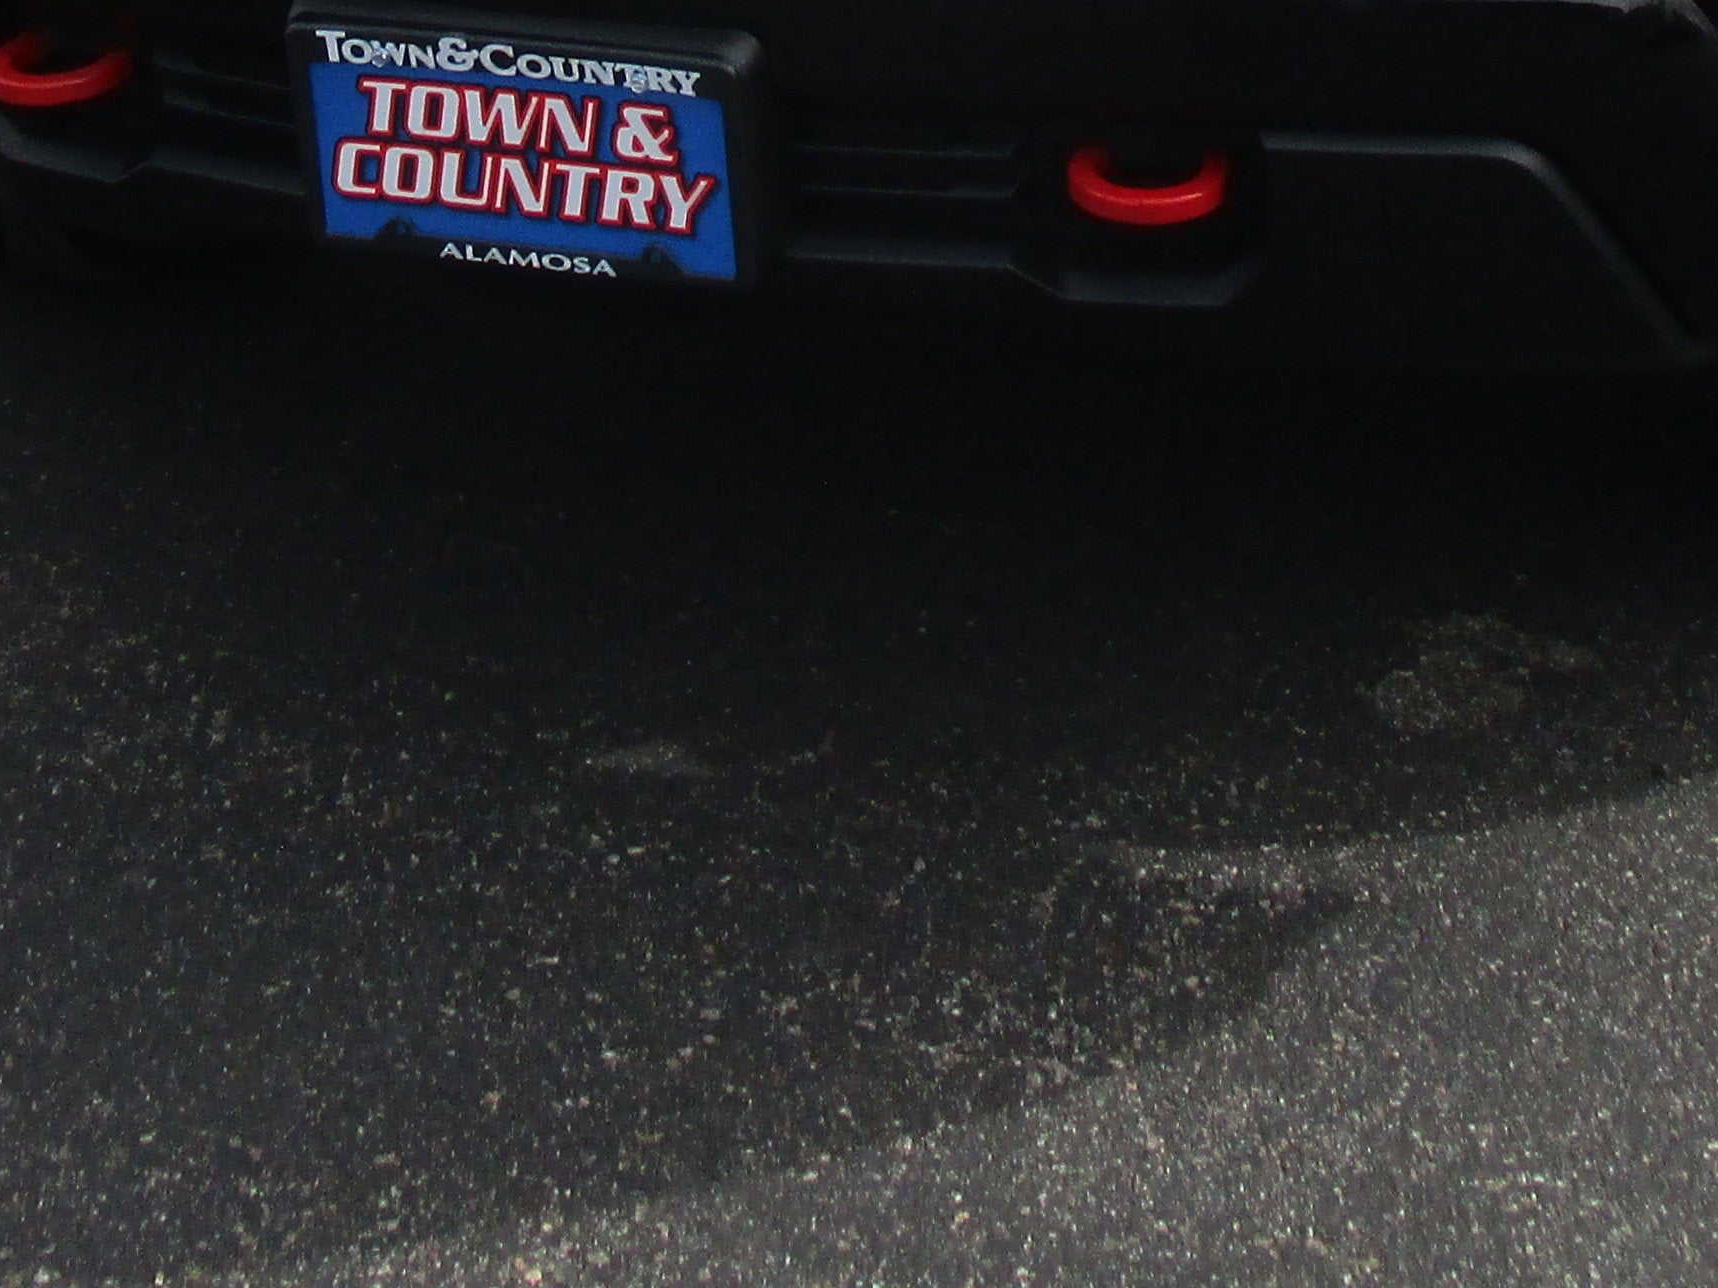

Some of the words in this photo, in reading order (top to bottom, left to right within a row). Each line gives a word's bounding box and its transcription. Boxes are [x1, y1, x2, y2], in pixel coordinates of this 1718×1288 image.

[359, 75, 600, 158] TOWN
[613, 101, 680, 165] &
[333, 138, 715, 236] COUNTRY
[439, 241, 617, 278] ALAMOSA
